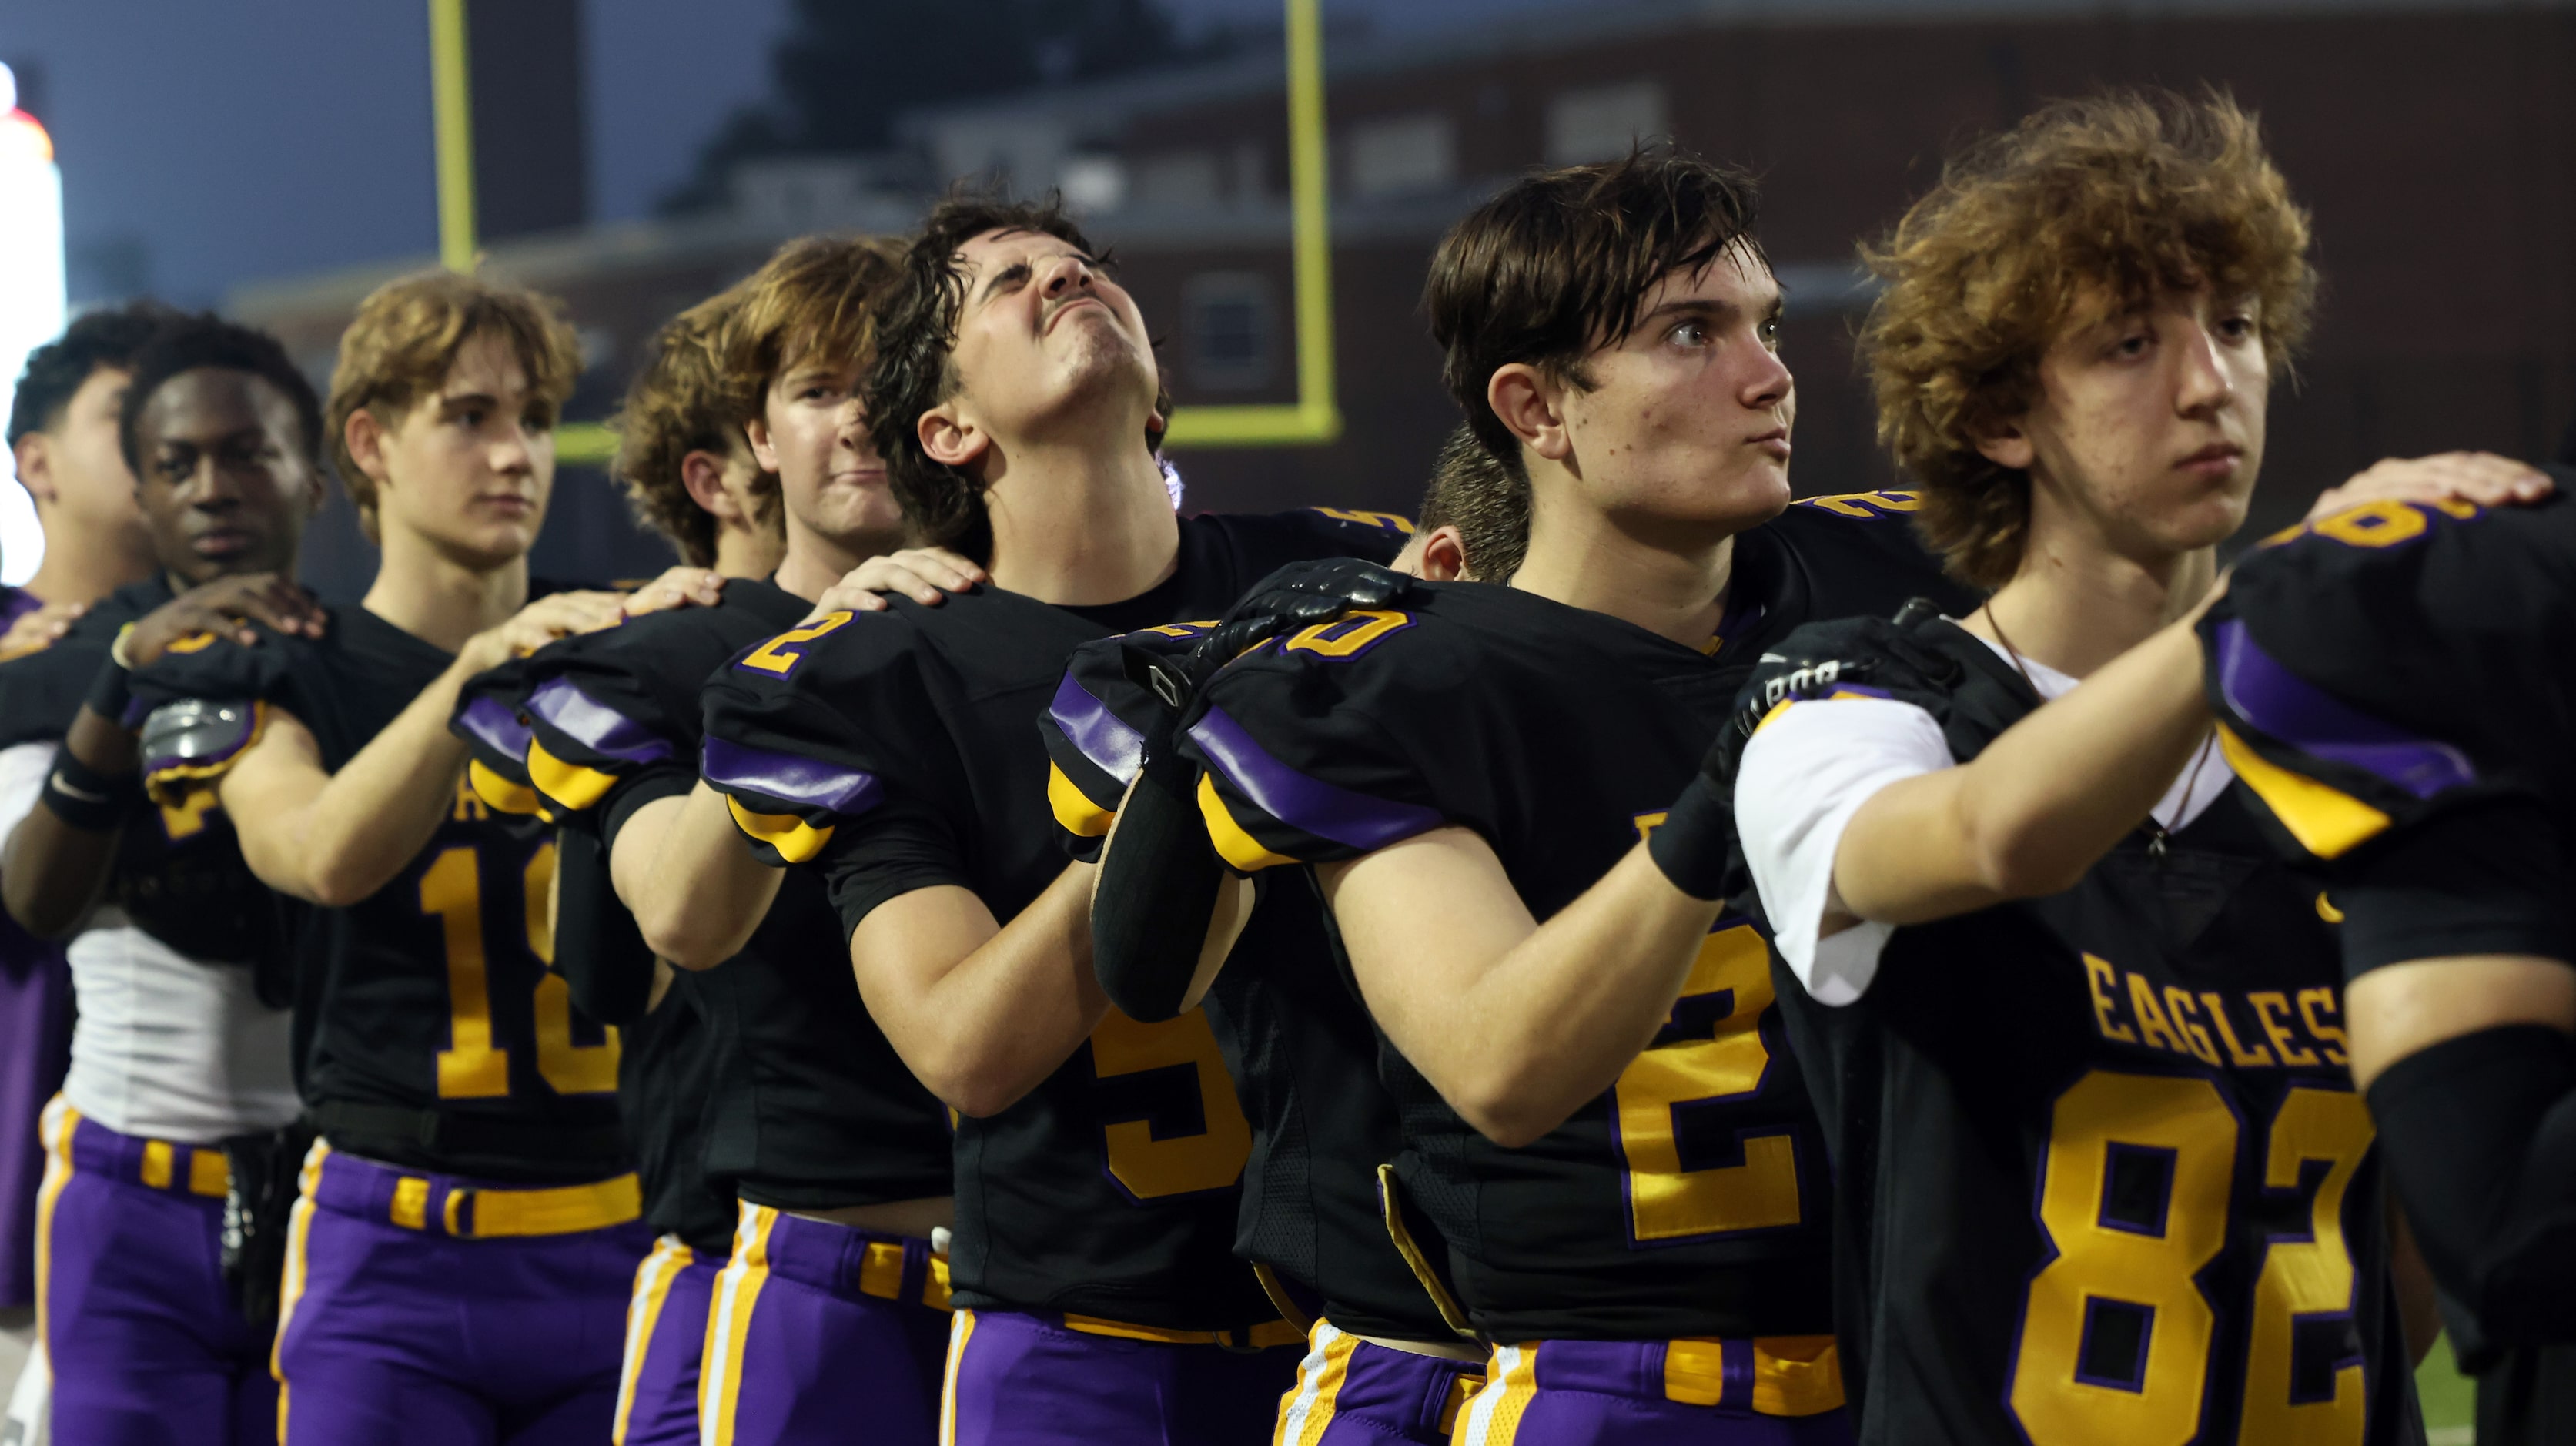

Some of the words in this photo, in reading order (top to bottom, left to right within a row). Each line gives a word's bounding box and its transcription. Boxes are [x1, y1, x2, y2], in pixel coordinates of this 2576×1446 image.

[736, 611, 855, 674] 2
[1236, 609, 1410, 658] 0
[2081, 950, 2350, 1069] EAGLES
[2009, 1069, 2377, 1446] 82
